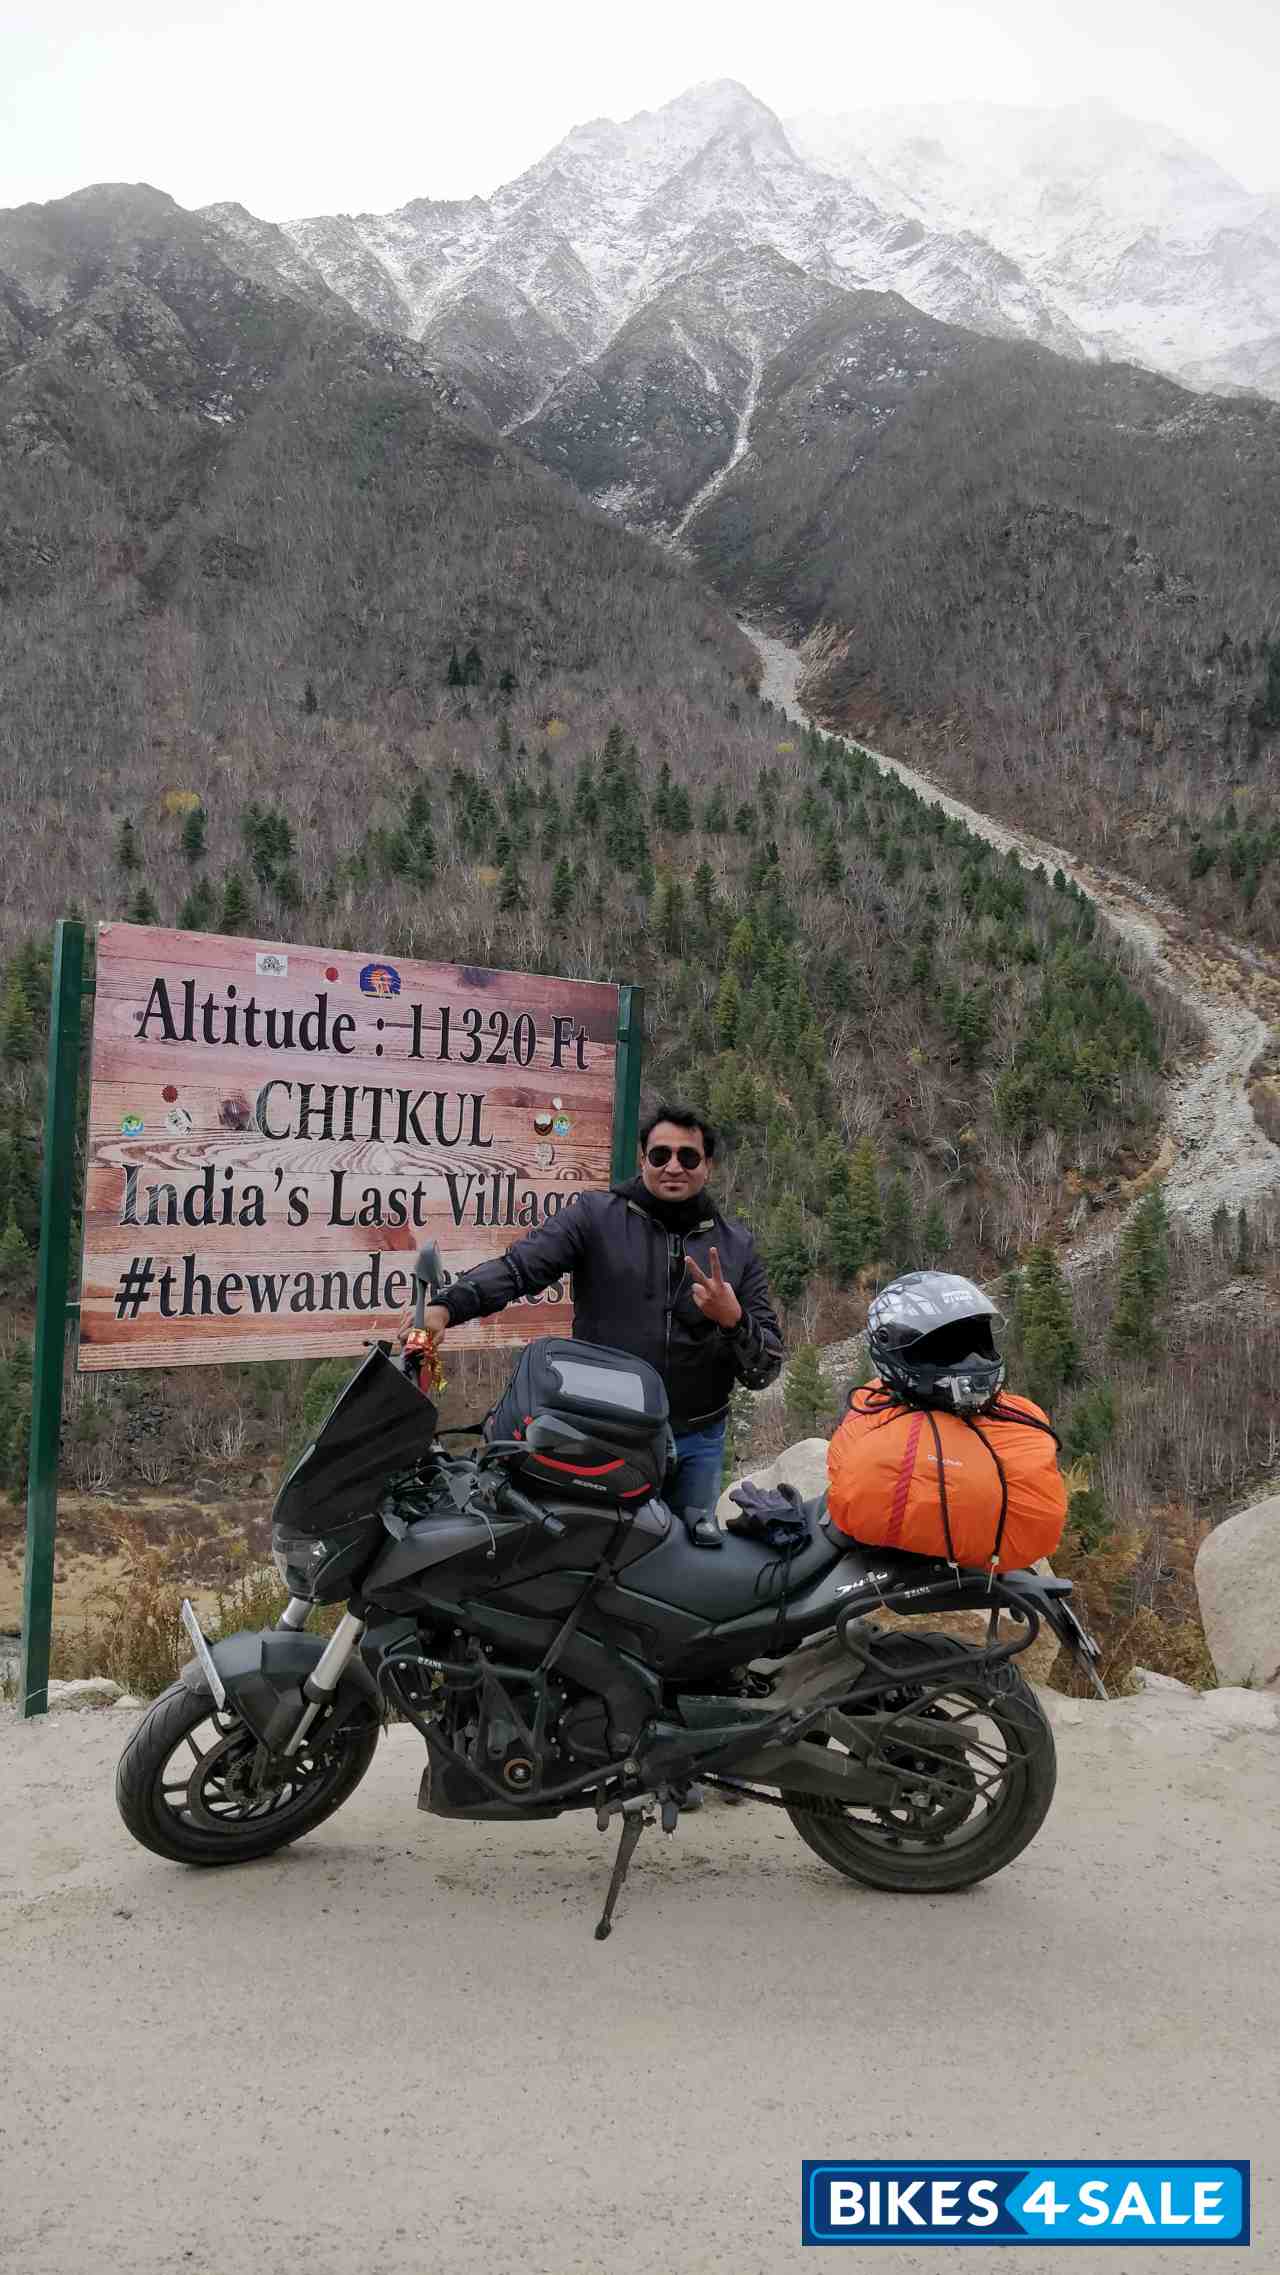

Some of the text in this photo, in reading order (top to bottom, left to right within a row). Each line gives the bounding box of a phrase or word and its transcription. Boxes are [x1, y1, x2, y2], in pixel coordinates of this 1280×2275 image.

[134, 977, 590, 1069] Altitude : 11320 Ft
[256, 1079, 493, 1147] CHITKUL
[120, 1163, 310, 1226] India’s
[330, 1169, 427, 1227] Last
